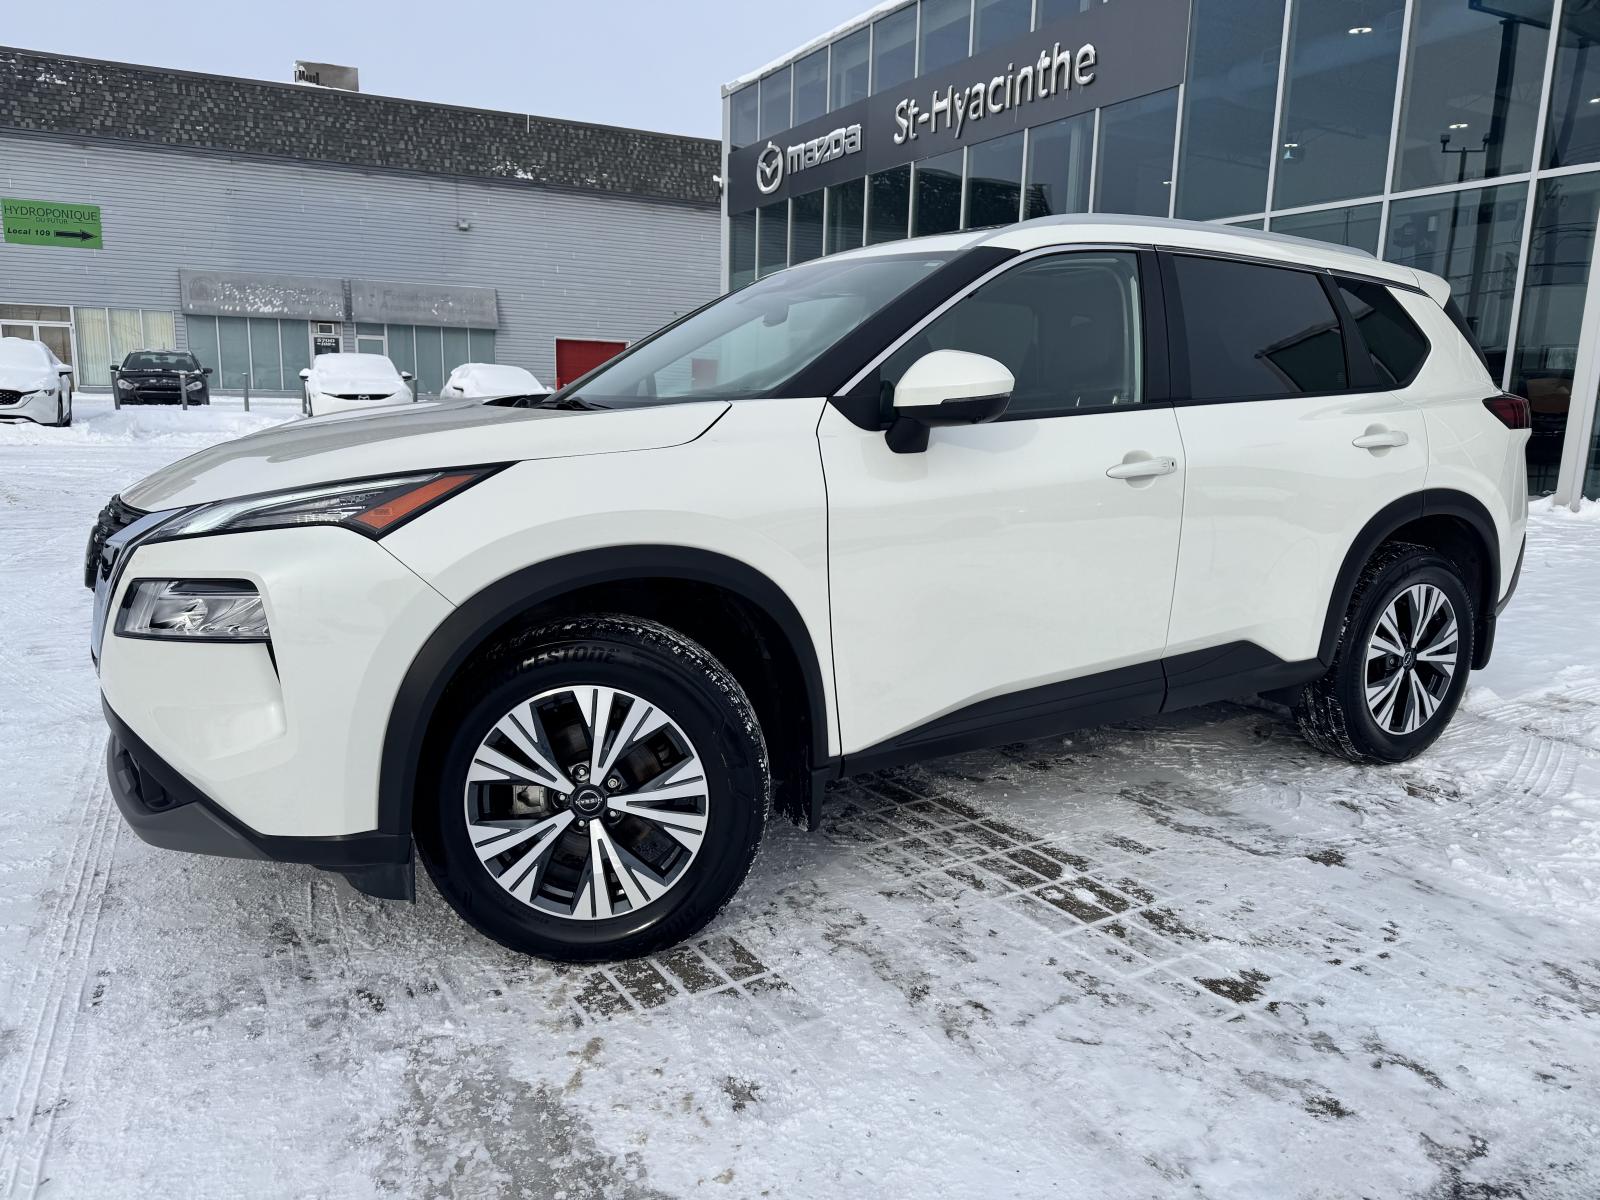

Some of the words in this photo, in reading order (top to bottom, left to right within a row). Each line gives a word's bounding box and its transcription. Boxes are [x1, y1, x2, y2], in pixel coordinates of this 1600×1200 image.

[893, 42, 1097, 145] St-Hyacinthe
[4, 205, 97, 220] HYDROPONIQUE
[7, 227, 31, 235] Local
